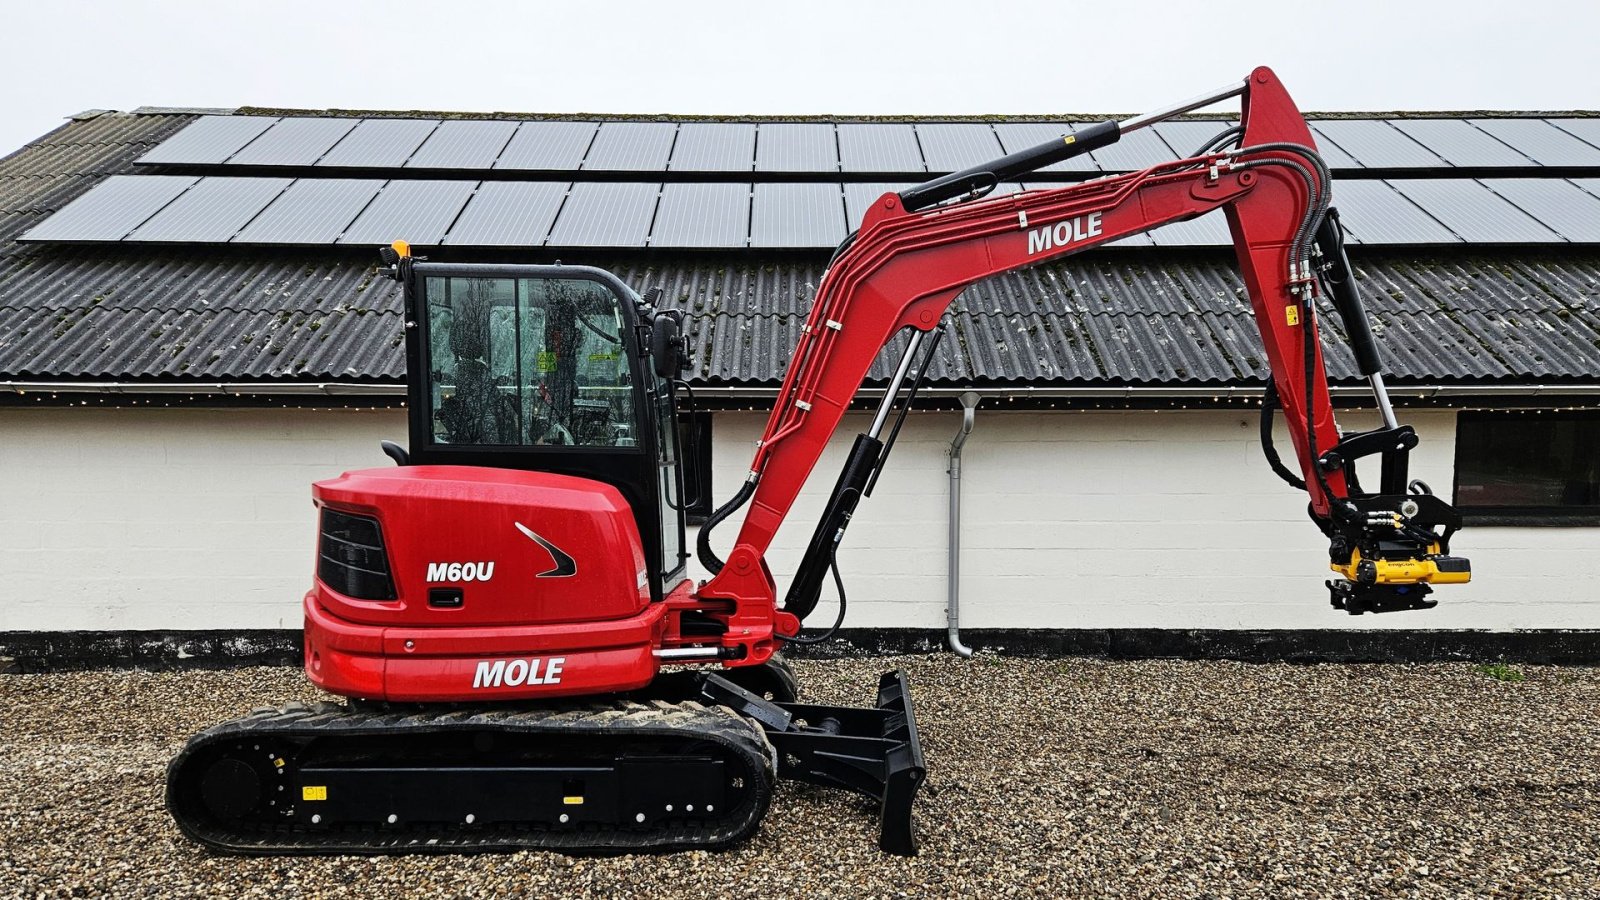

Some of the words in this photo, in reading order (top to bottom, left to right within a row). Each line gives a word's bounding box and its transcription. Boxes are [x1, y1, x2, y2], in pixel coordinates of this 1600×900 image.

[1028, 211, 1103, 255] MOLE
[426, 561, 495, 582] M60U
[472, 657, 566, 688] MOLE
